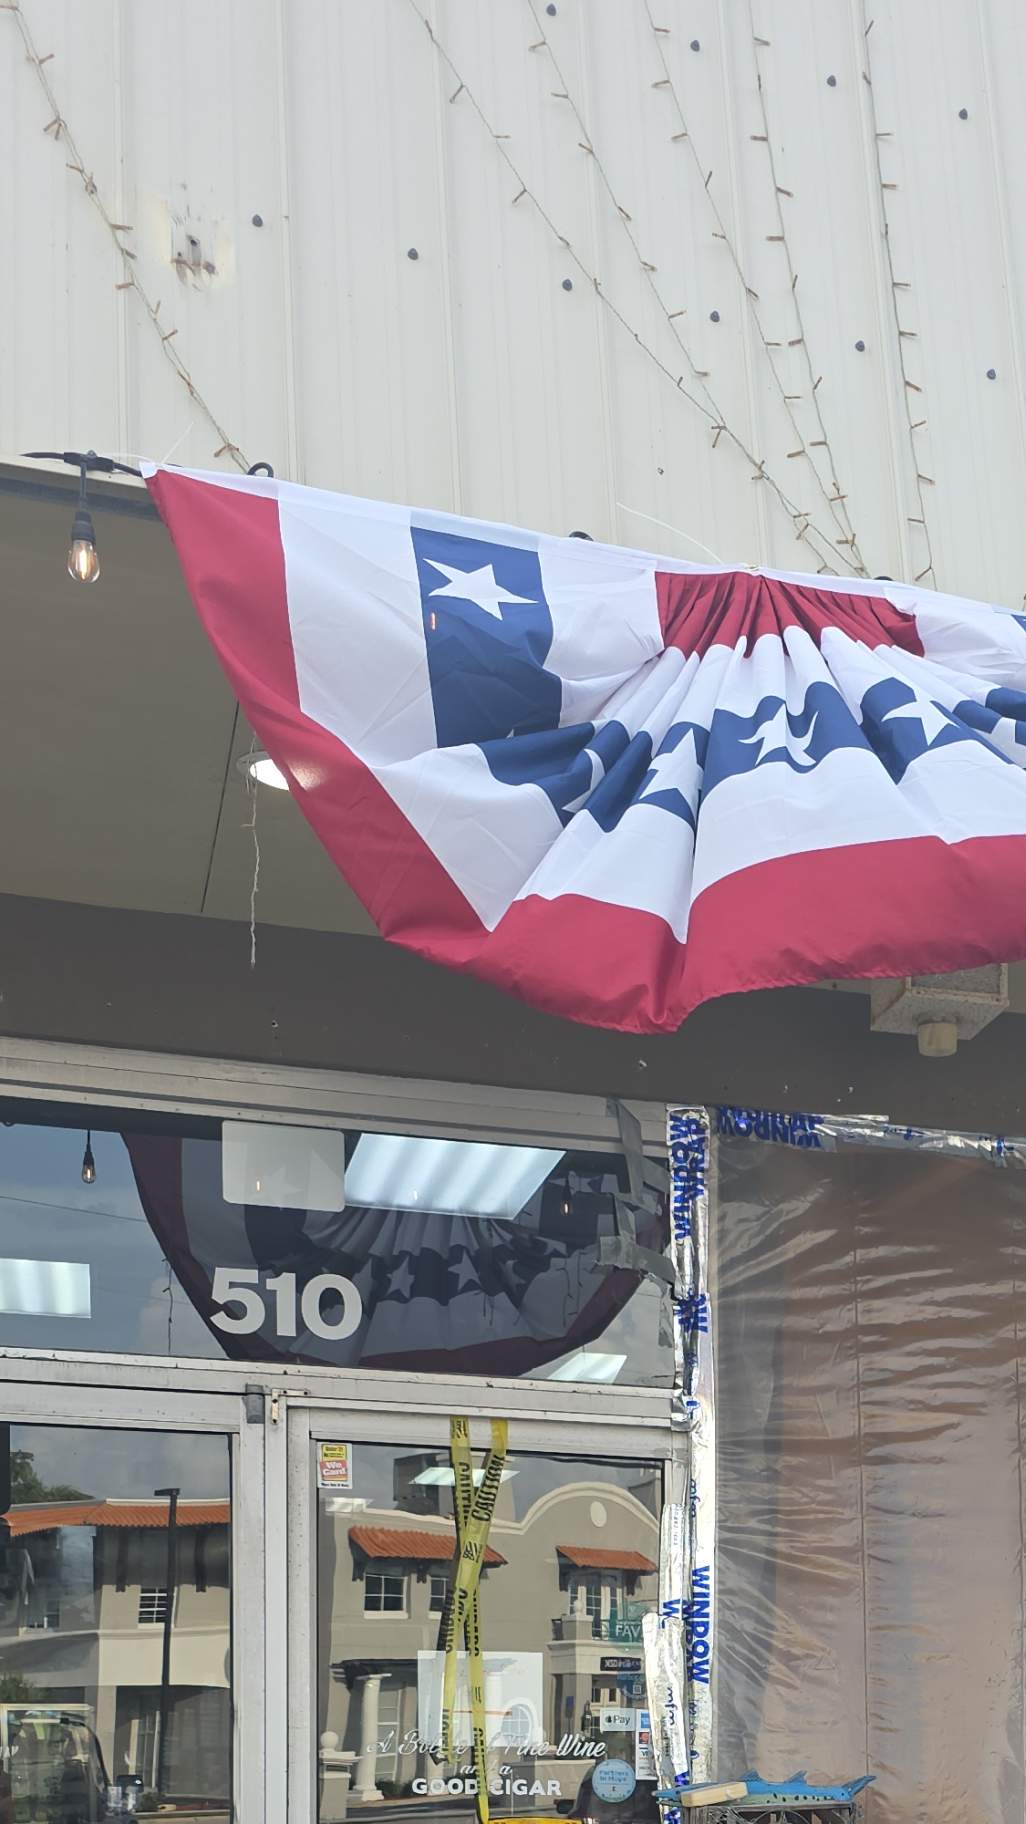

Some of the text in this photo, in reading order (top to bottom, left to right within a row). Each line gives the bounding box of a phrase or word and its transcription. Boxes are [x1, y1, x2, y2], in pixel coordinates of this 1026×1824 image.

[209, 1266, 363, 1341] 510
[692, 1565, 711, 1685] WINDOW
[613, 1715, 631, 1726] Pay
[554, 1733, 607, 1758] Wine
[411, 1778, 562, 1796] GOOD CIGAR
